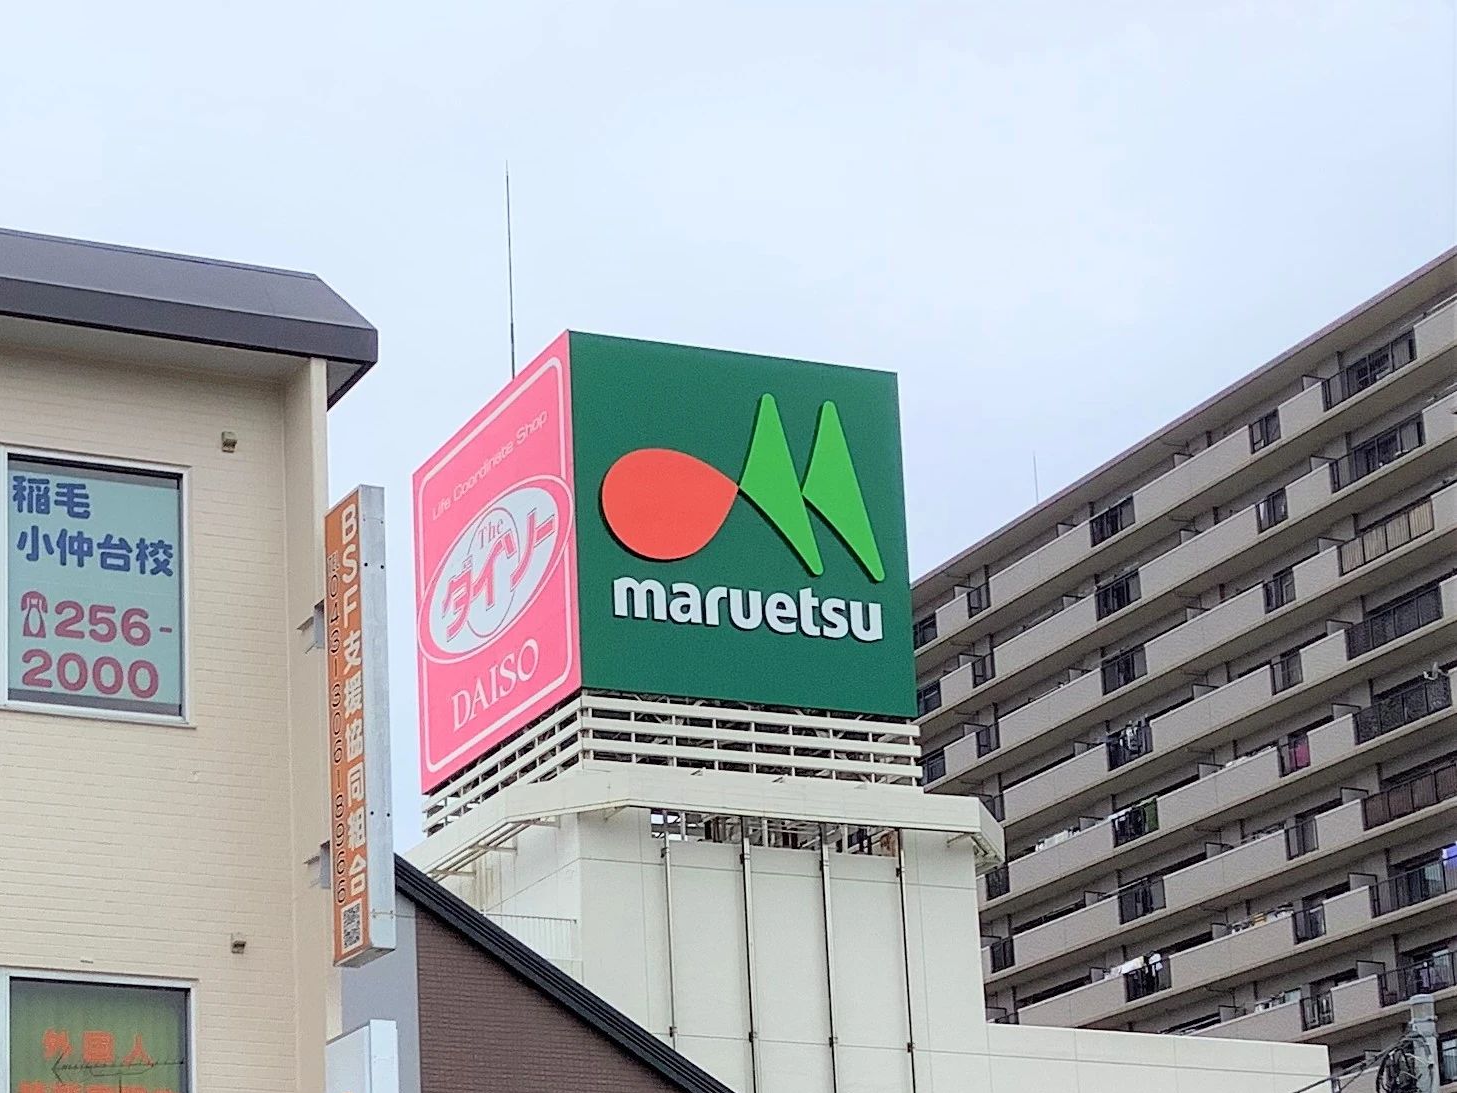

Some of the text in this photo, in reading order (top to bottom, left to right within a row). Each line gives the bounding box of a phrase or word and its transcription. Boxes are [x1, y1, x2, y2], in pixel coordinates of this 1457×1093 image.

[433, 410, 547, 520] Life Coordinate Shop
[12, 475, 91, 520] 稲毛
[17, 526, 175, 577] 小仲台校
[478, 516, 504, 553] The
[444, 507, 556, 643] ダイソー
[613, 575, 884, 642] maruetsu
[21, 649, 160, 699] 2000
[451, 638, 538, 731] DAISO
